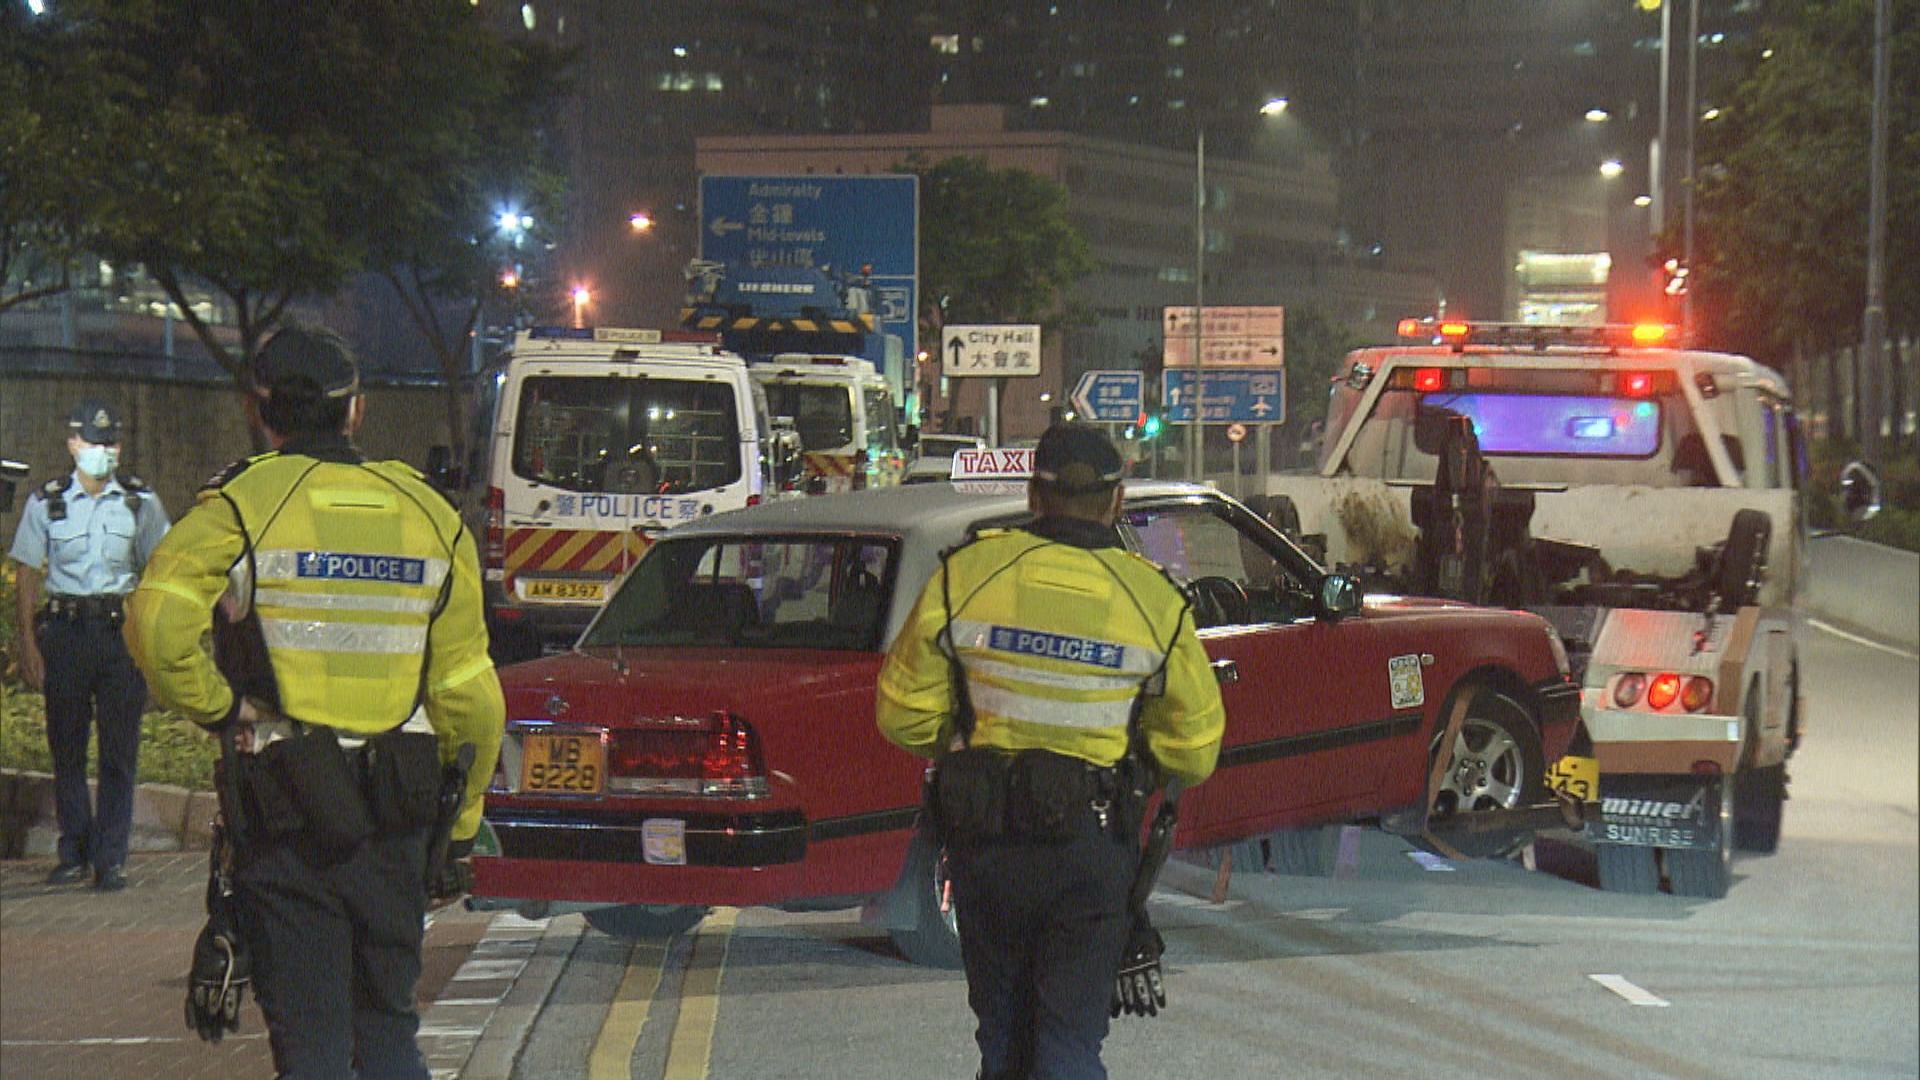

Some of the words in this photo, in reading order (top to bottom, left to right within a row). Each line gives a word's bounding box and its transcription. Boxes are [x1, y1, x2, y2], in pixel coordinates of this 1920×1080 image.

[750, 183, 822, 199] Admiralty
[738, 282, 815, 293] LIEBHERR
[969, 331, 999, 345] City
[1003, 330, 1033, 343] Hall
[970, 350, 1032, 368] 大會堂
[581, 496, 673, 518] POLICE
[327, 556, 401, 580] POLICE
[531, 583, 553, 595] AM
[557, 584, 598, 597] 8397
[1018, 633, 1094, 661] POLICE
[529, 764, 596, 790] 9228
[1607, 824, 1695, 845] SUNRISE
